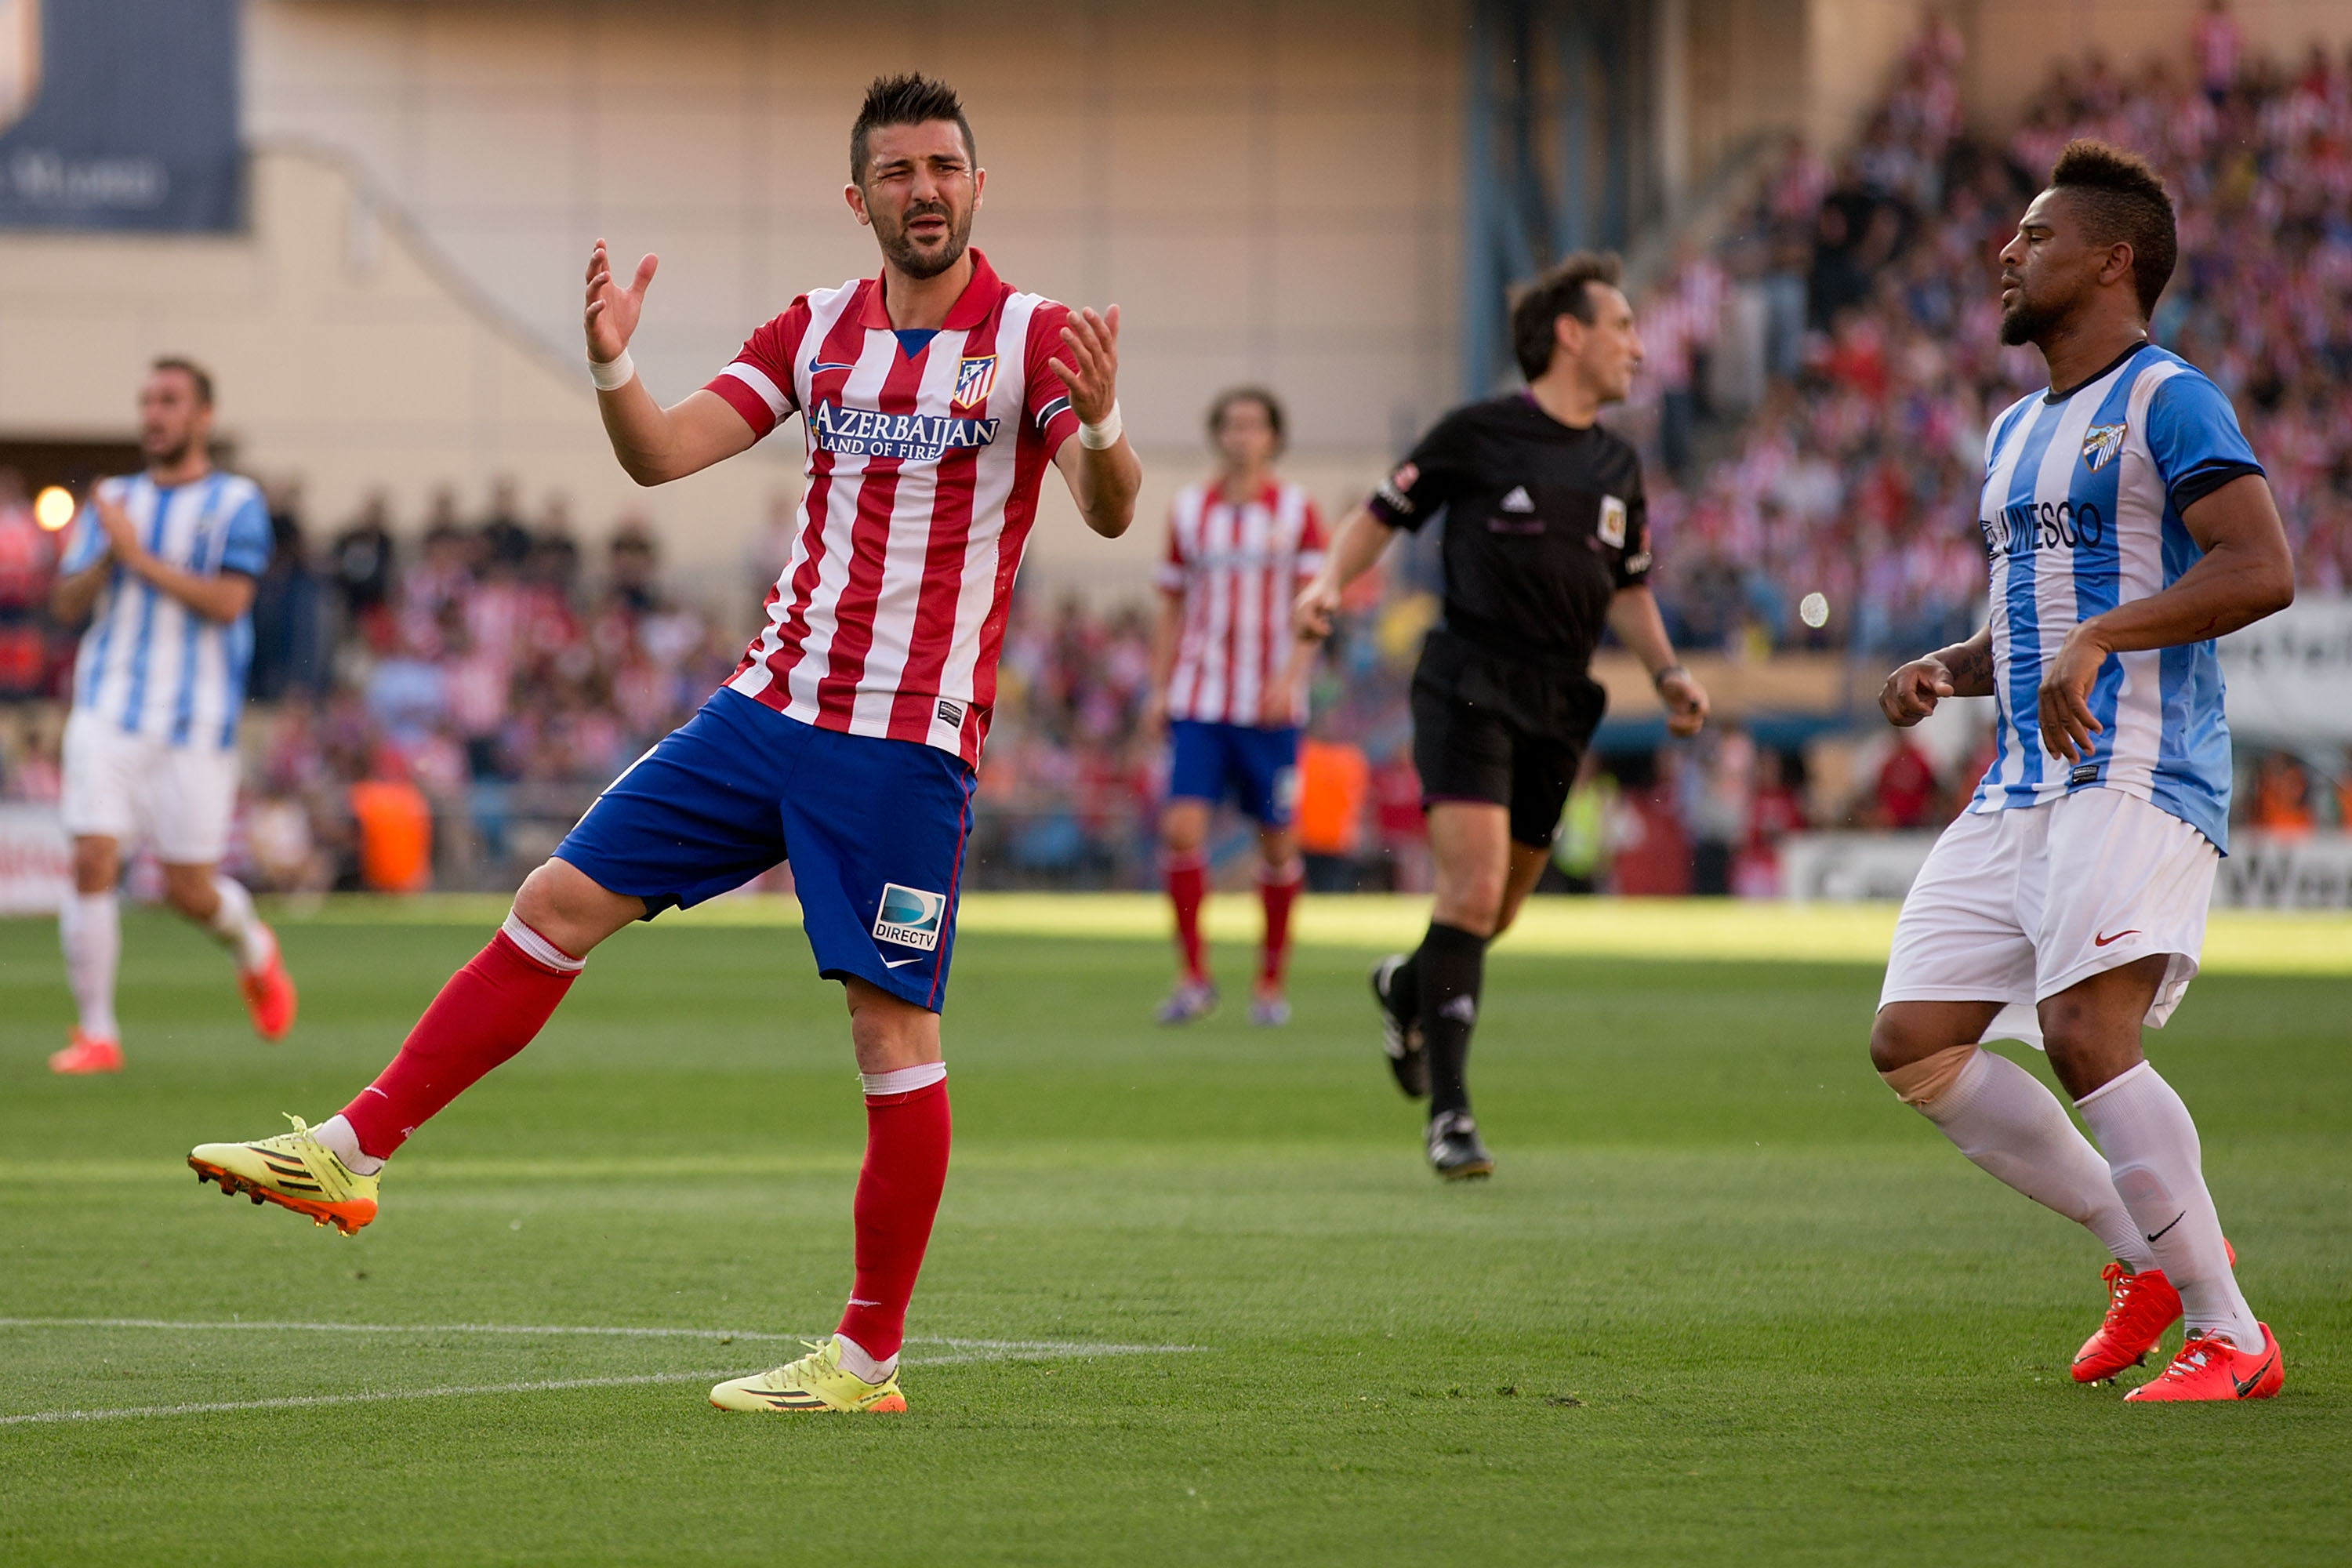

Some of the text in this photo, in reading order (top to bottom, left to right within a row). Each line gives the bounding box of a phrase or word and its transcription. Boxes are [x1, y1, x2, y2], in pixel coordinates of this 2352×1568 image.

[816, 399, 999, 457] AZERBAIJAN
[821, 435, 937, 460] LAND OF FIRE
[2002, 501, 2101, 554] UNESCO
[876, 924, 934, 946] DIRECTV
